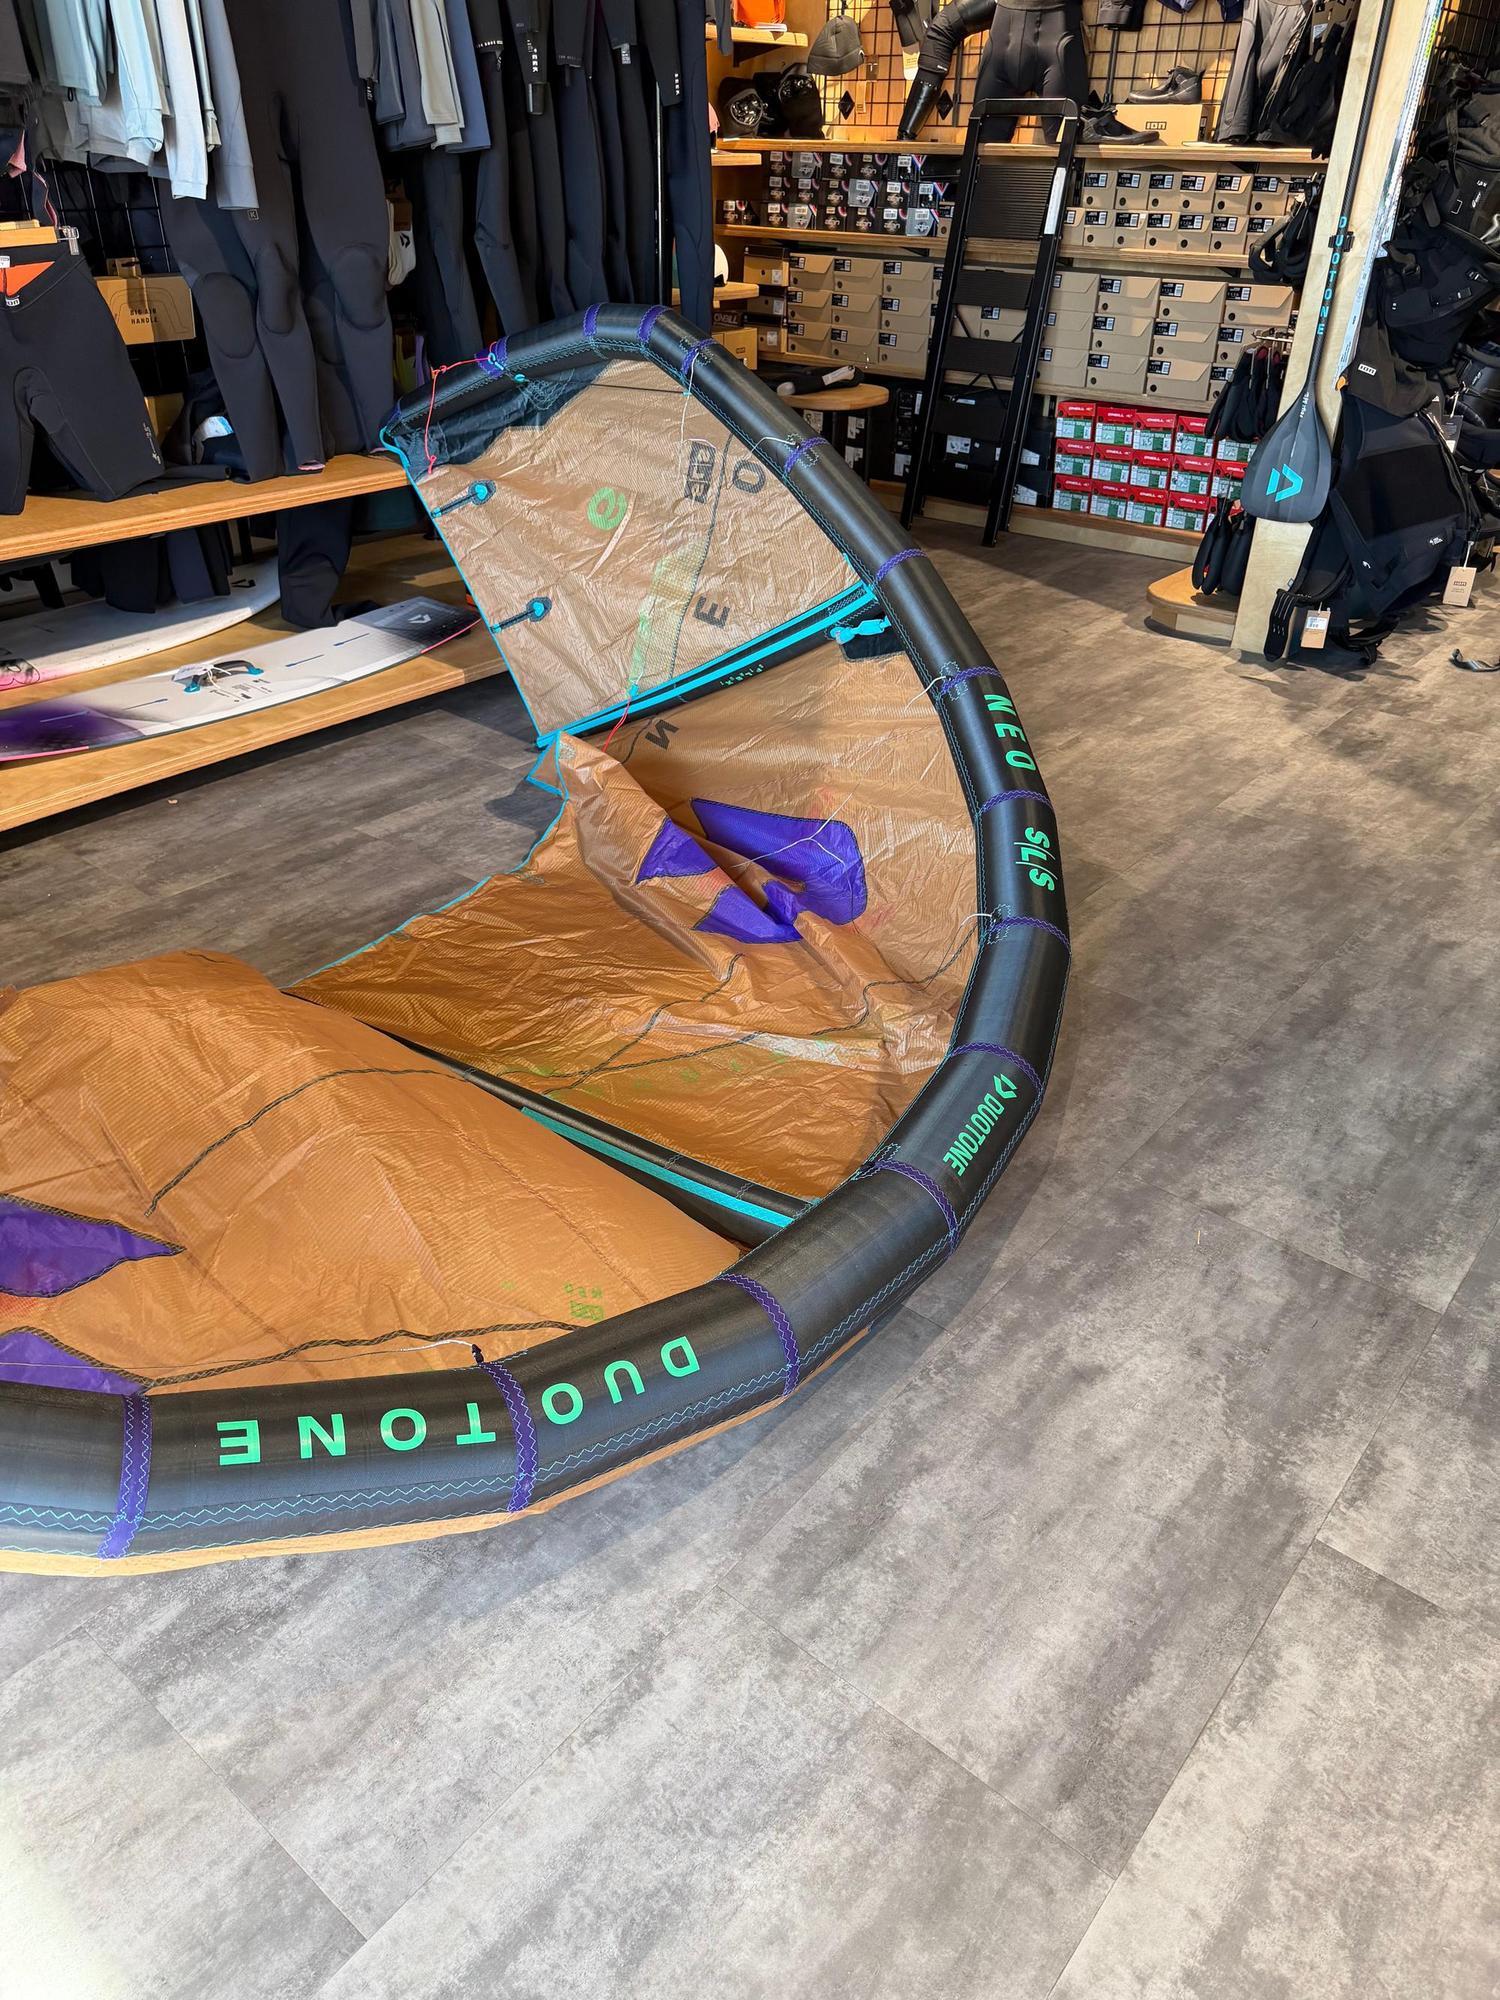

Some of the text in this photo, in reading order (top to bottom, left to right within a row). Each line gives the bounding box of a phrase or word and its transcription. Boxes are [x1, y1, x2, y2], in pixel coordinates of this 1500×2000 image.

[1317, 216, 1348, 336] DUOTONE
[984, 694, 1036, 772] NEO
[943, 1093, 1004, 1176] DUOTONE
